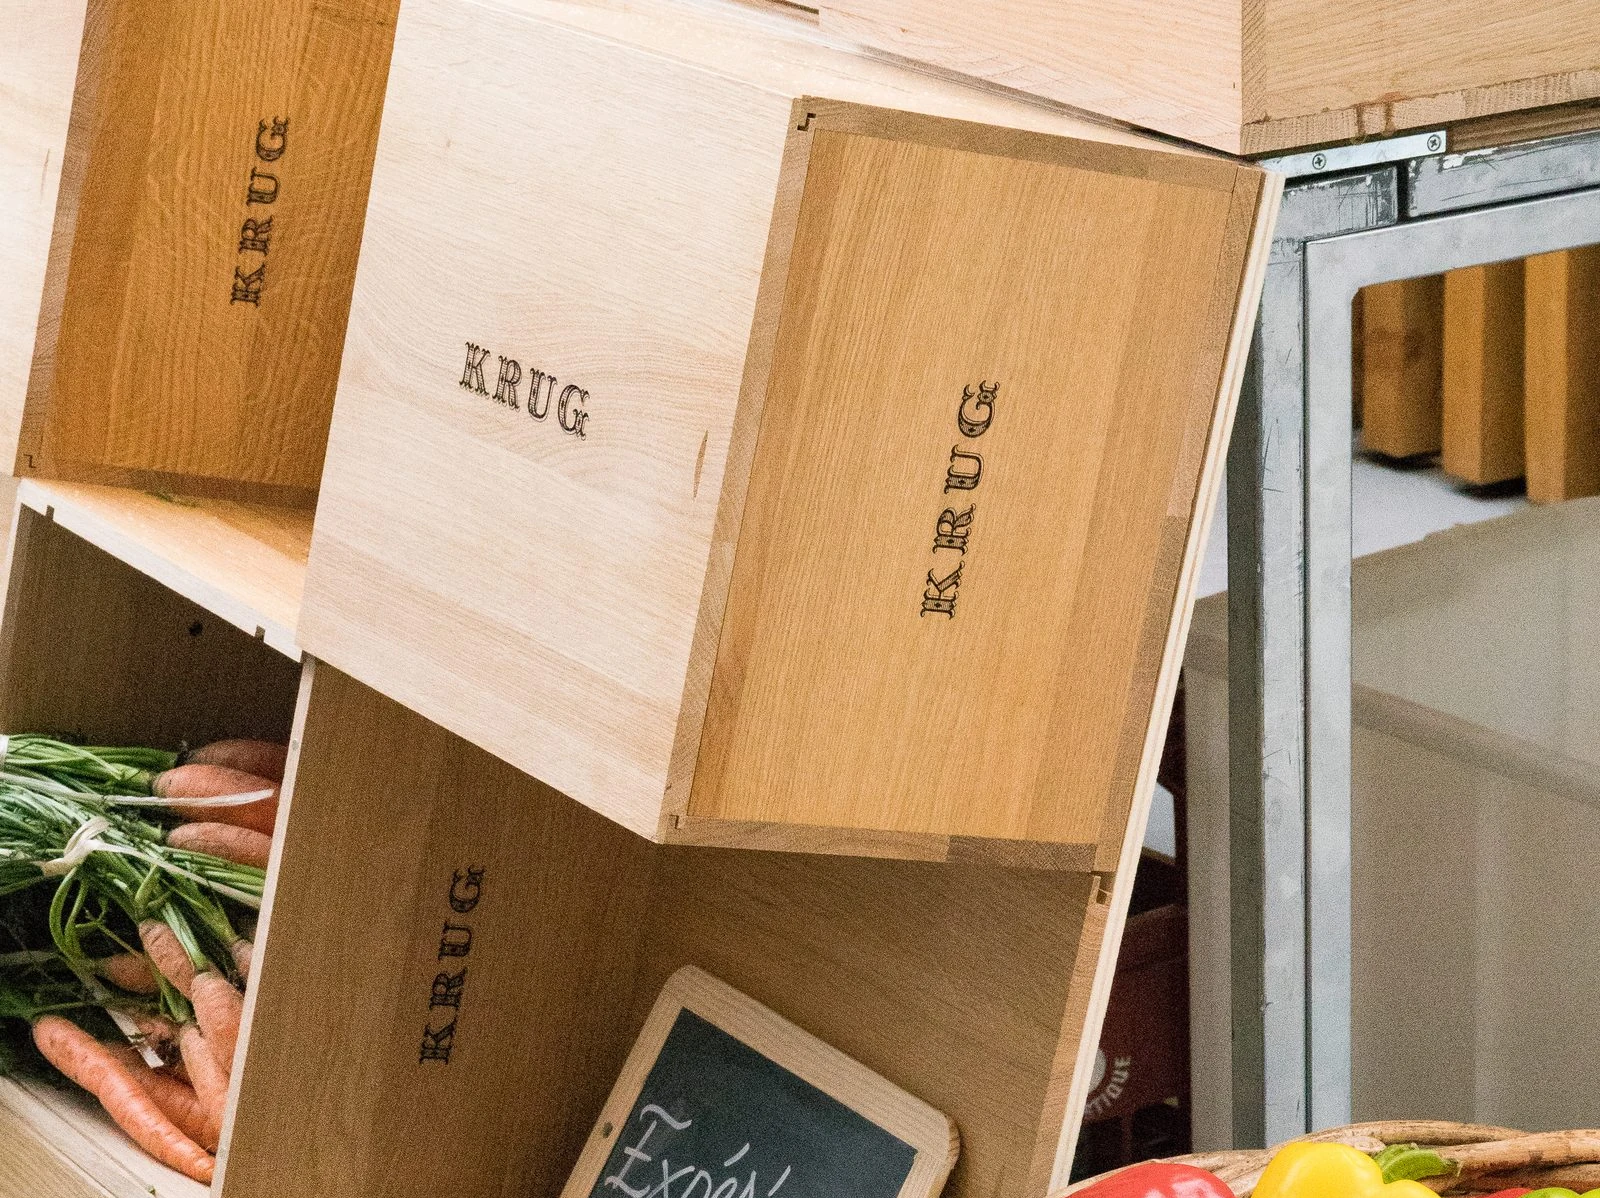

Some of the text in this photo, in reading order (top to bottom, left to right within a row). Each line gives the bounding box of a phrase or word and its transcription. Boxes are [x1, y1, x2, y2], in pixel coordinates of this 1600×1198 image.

[229, 115, 290, 308] KRUG
[459, 341, 591, 441] KRUG
[920, 379, 1001, 620] KRUG
[419, 864, 487, 1066] KRUG
